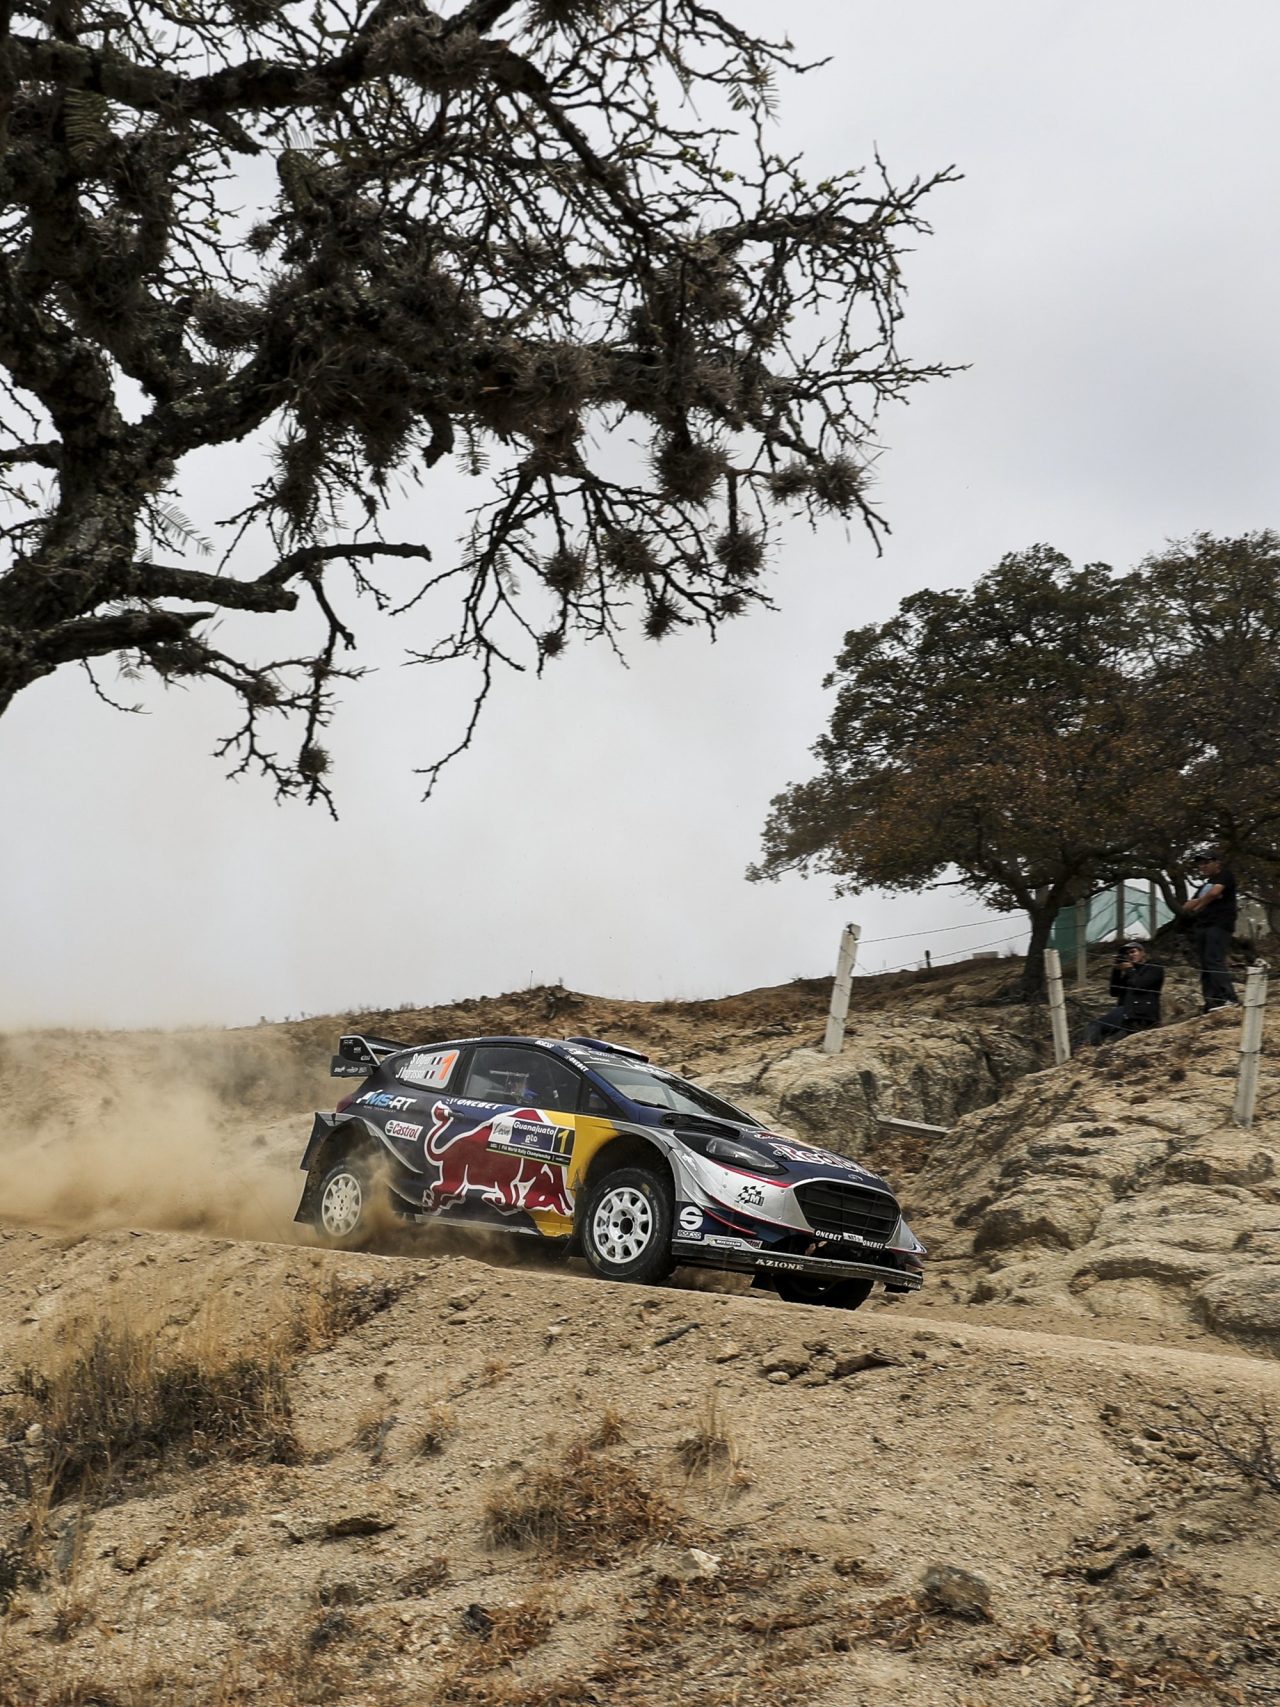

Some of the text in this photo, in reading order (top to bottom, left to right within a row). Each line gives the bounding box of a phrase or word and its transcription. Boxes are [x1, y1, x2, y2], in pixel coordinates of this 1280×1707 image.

[438, 1051, 458, 1081] 1
[392, 1123, 419, 1140] Castrol
[513, 1121, 555, 1136] Guanajuato
[524, 1134, 538, 1143] gto
[557, 1129, 570, 1154] 1
[815, 1229, 843, 1241] ONEBET
[862, 1240, 885, 1249] ONEBET
[755, 1259, 805, 1271] AZIONE
